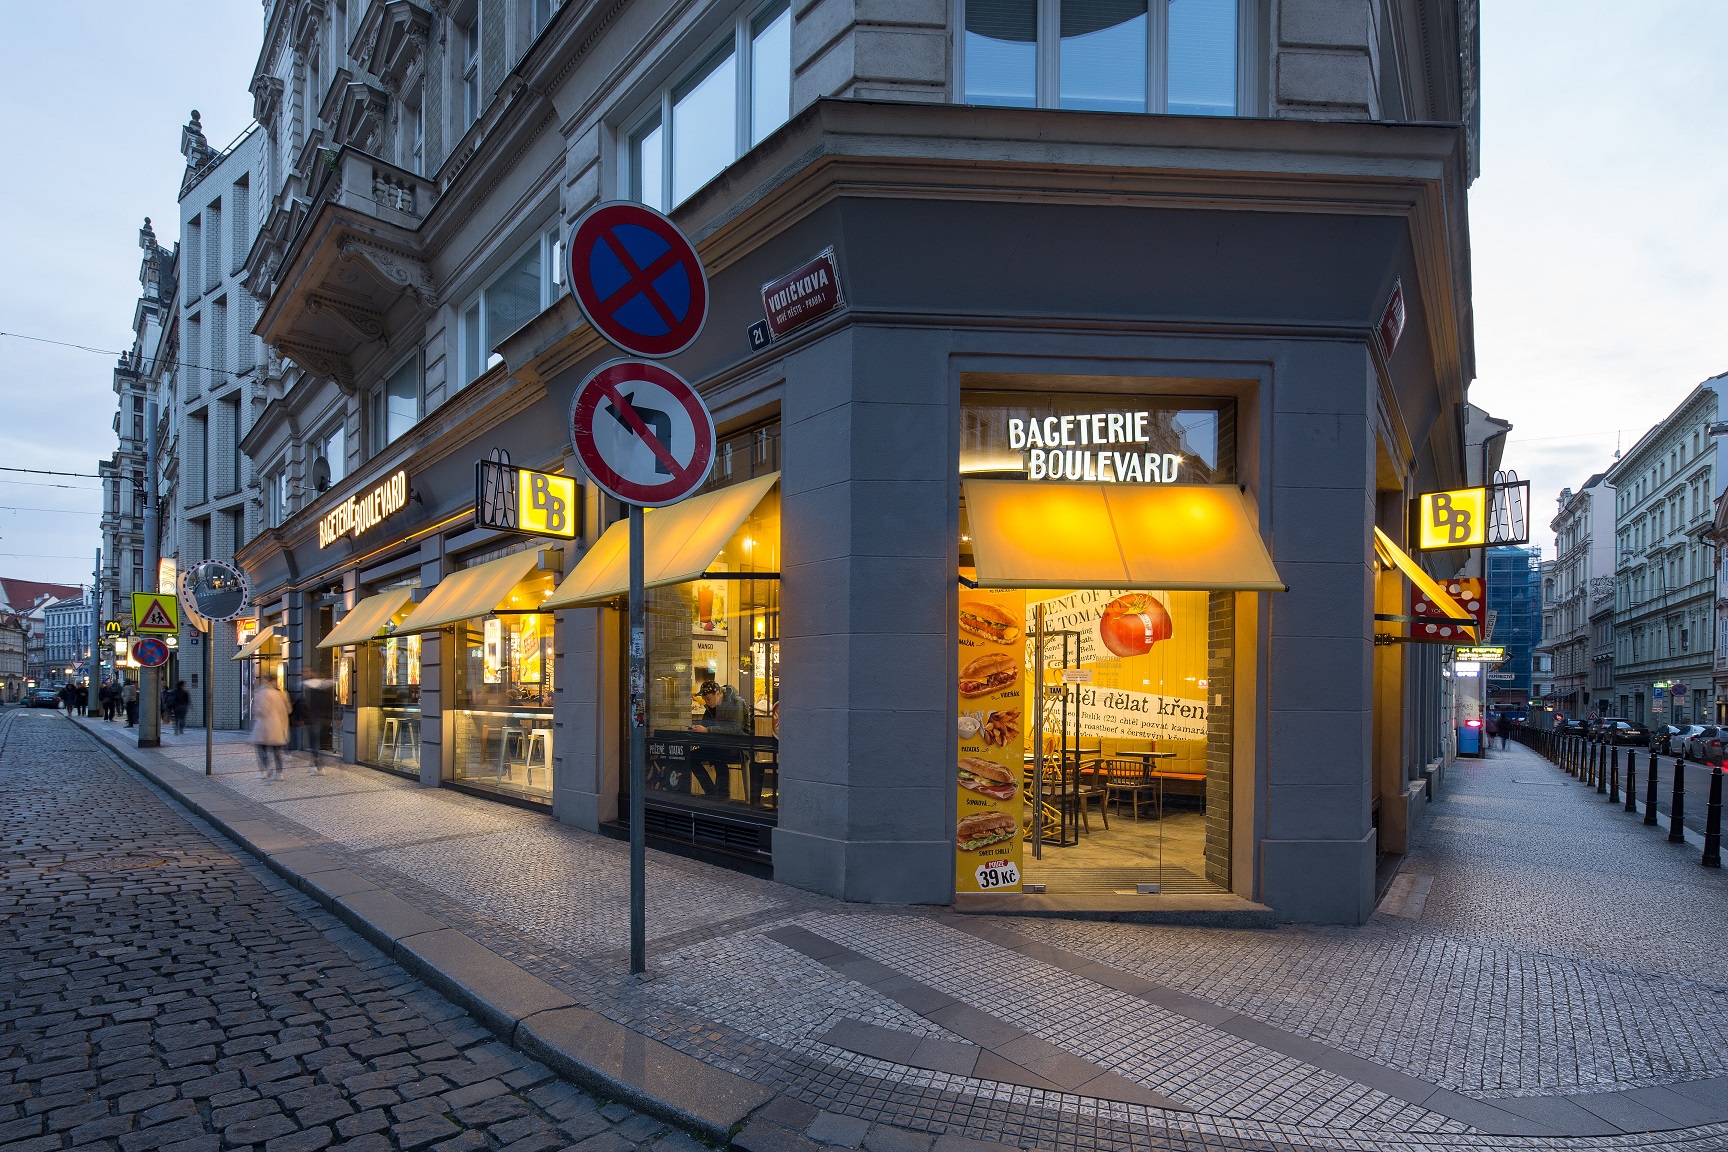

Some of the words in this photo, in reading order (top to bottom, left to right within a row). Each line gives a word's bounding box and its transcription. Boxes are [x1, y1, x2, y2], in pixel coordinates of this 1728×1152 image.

[768, 269, 829, 313] VODIČKOVA
[805, 294, 822, 309] PRAHA
[821, 292, 826, 301] 1
[753, 327, 764, 345] 21
[1009, 411, 1149, 449] BAGETERIE
[1030, 449, 1178, 483] BOULEVARD
[354, 470, 406, 537] BOULEVARD
[319, 496, 356, 549] BAGETERIE
[692, 650, 718, 662] LATTE
[1104, 691, 1149, 713] dělat
[1157, 697, 1208, 721] křen
[1104, 714, 1117, 724] (22)
[1119, 716, 1139, 726] chtěl
[1141, 720, 1168, 730] pozvat
[978, 849, 994, 857] SWEET
[979, 869, 1000, 888] 39
